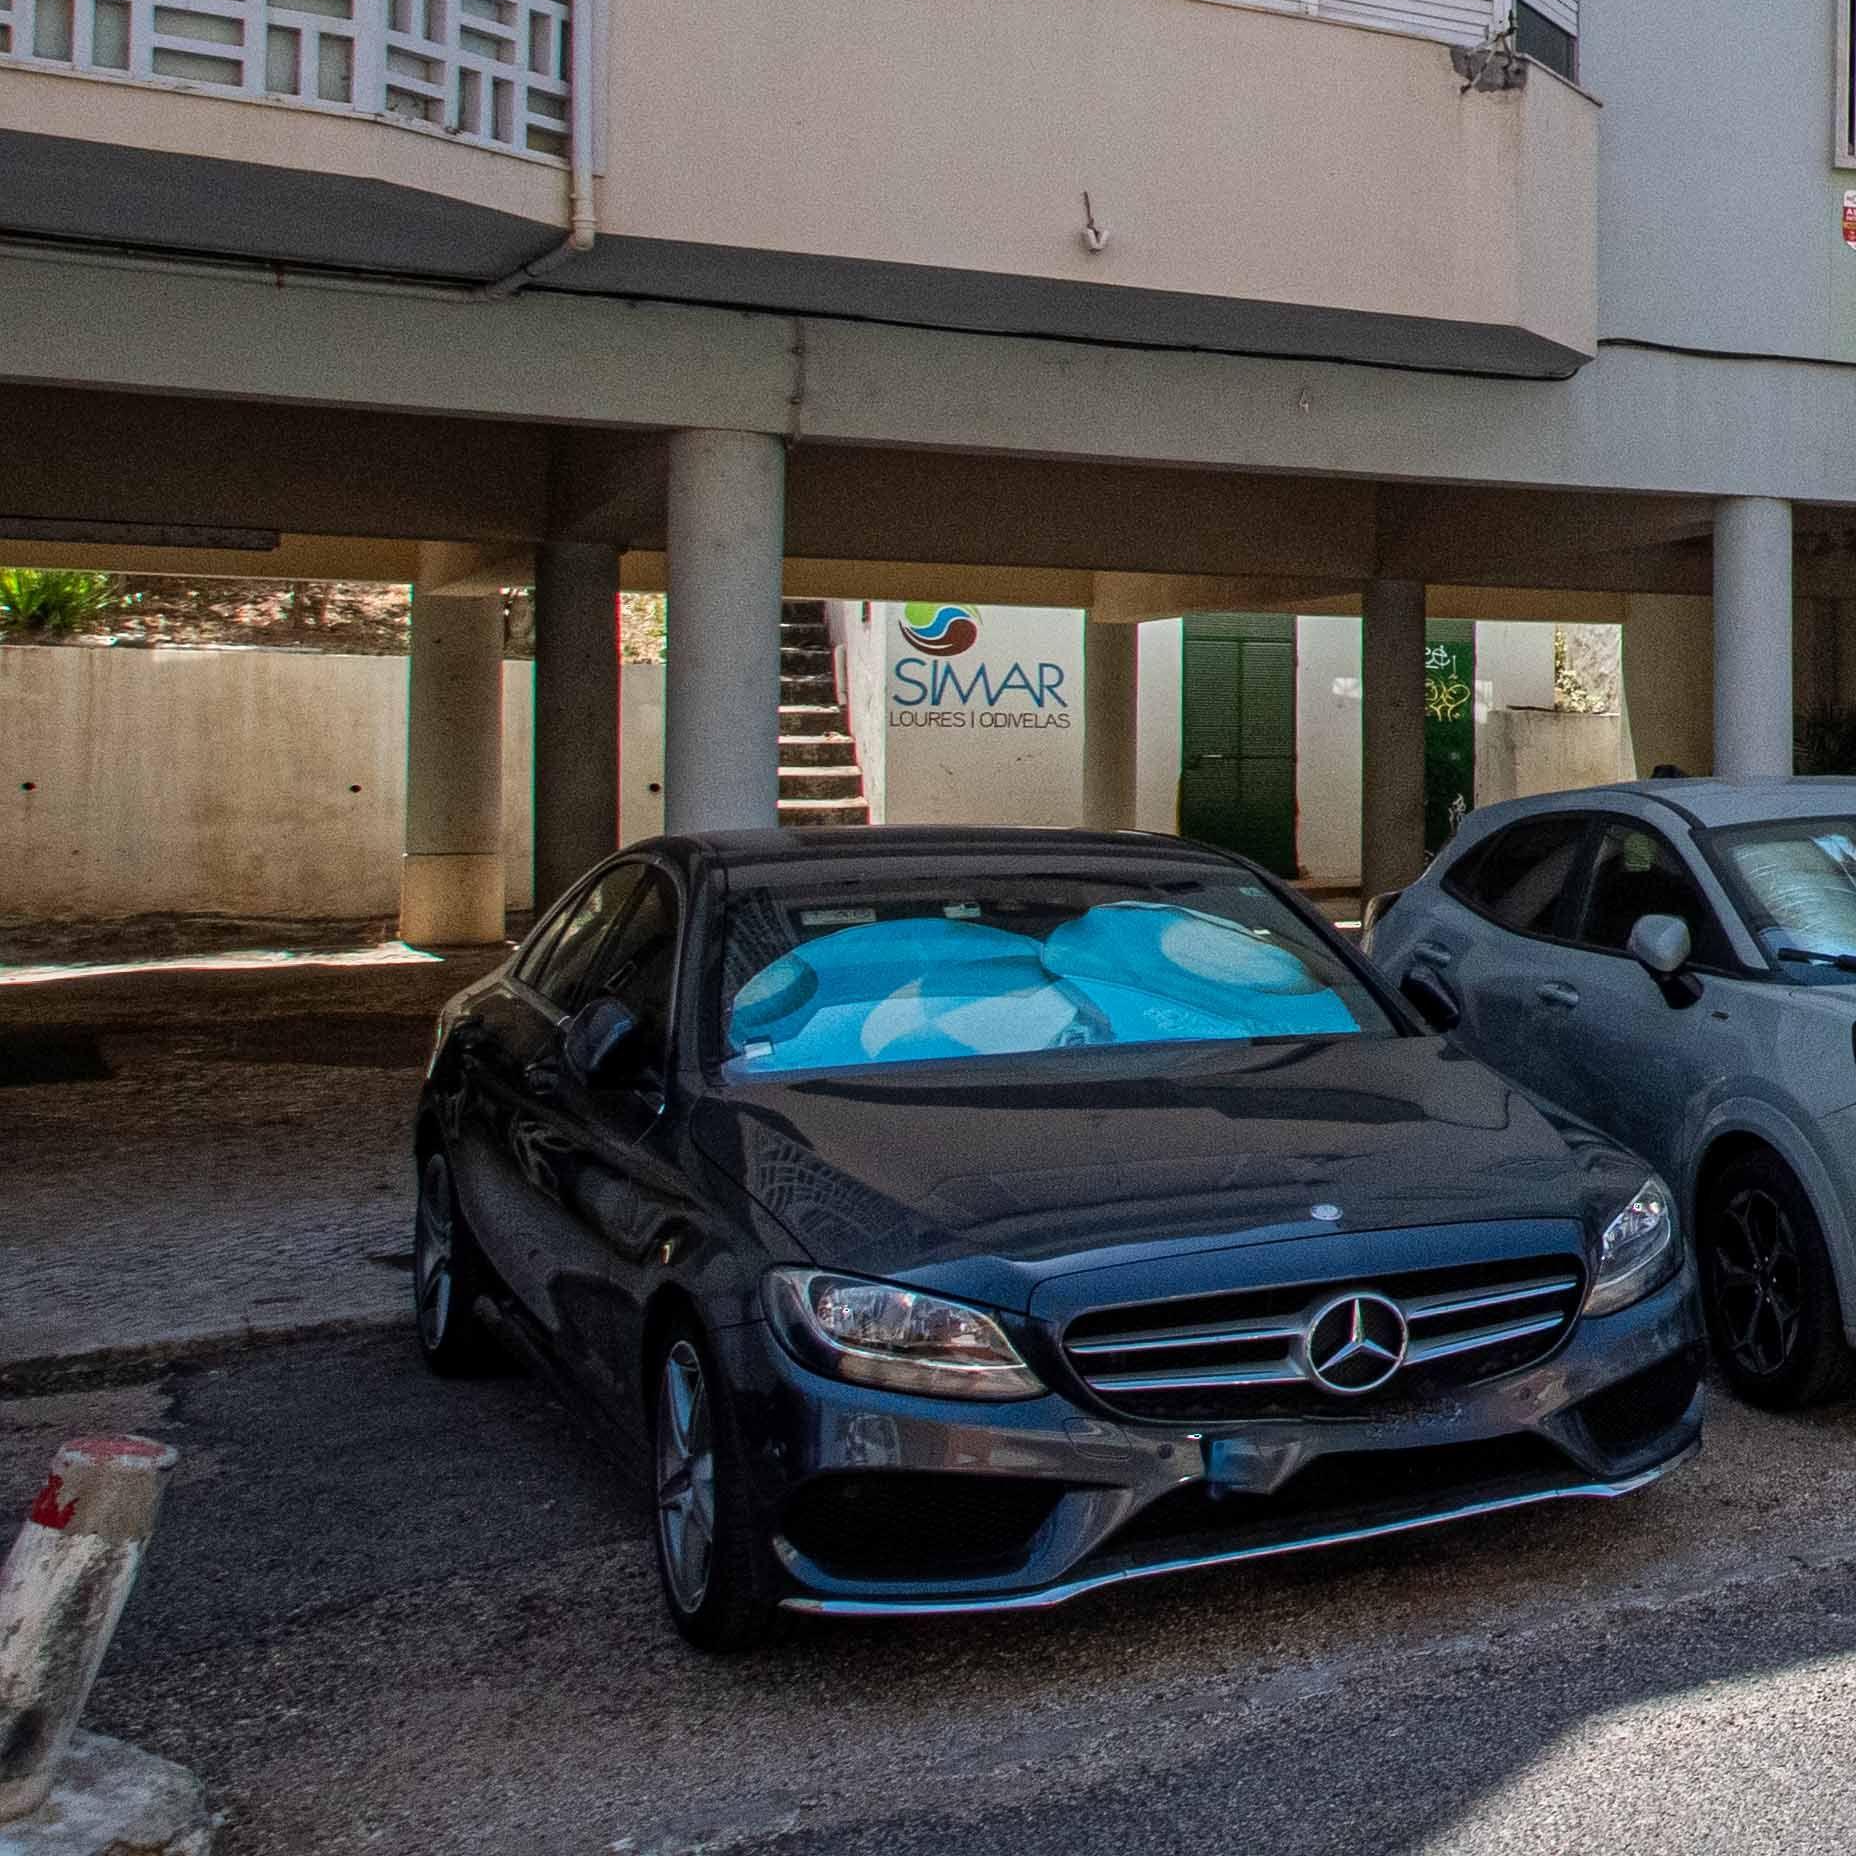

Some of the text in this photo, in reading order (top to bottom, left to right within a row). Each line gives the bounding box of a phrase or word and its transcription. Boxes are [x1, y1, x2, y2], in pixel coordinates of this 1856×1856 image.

[892, 657, 1068, 708] SIMAR
[889, 710, 967, 729] LOURES
[979, 712, 1072, 730] ODIVELAS
